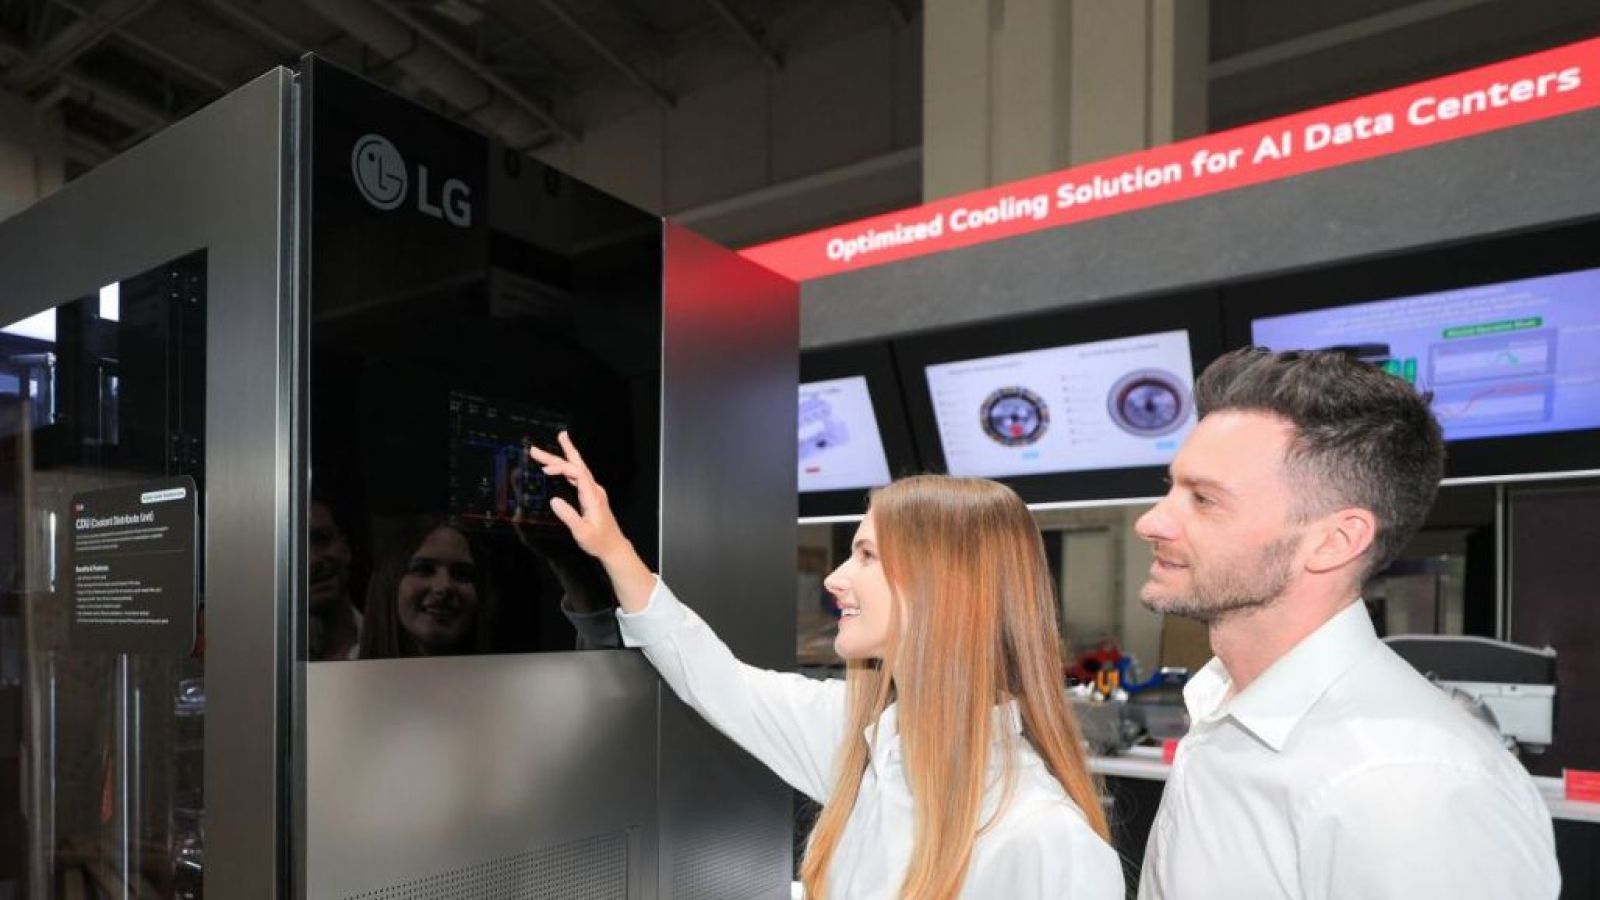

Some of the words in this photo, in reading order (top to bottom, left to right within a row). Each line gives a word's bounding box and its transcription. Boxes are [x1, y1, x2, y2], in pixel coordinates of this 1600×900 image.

[418, 165, 473, 227] LG
[826, 213, 944, 262] Optimized
[949, 194, 1049, 232] Cooling
[1056, 163, 1182, 209] Solution
[1191, 148, 1243, 177] for
[1252, 131, 1292, 164] AI
[1304, 113, 1394, 151] Data
[1407, 67, 1581, 126] Centers
